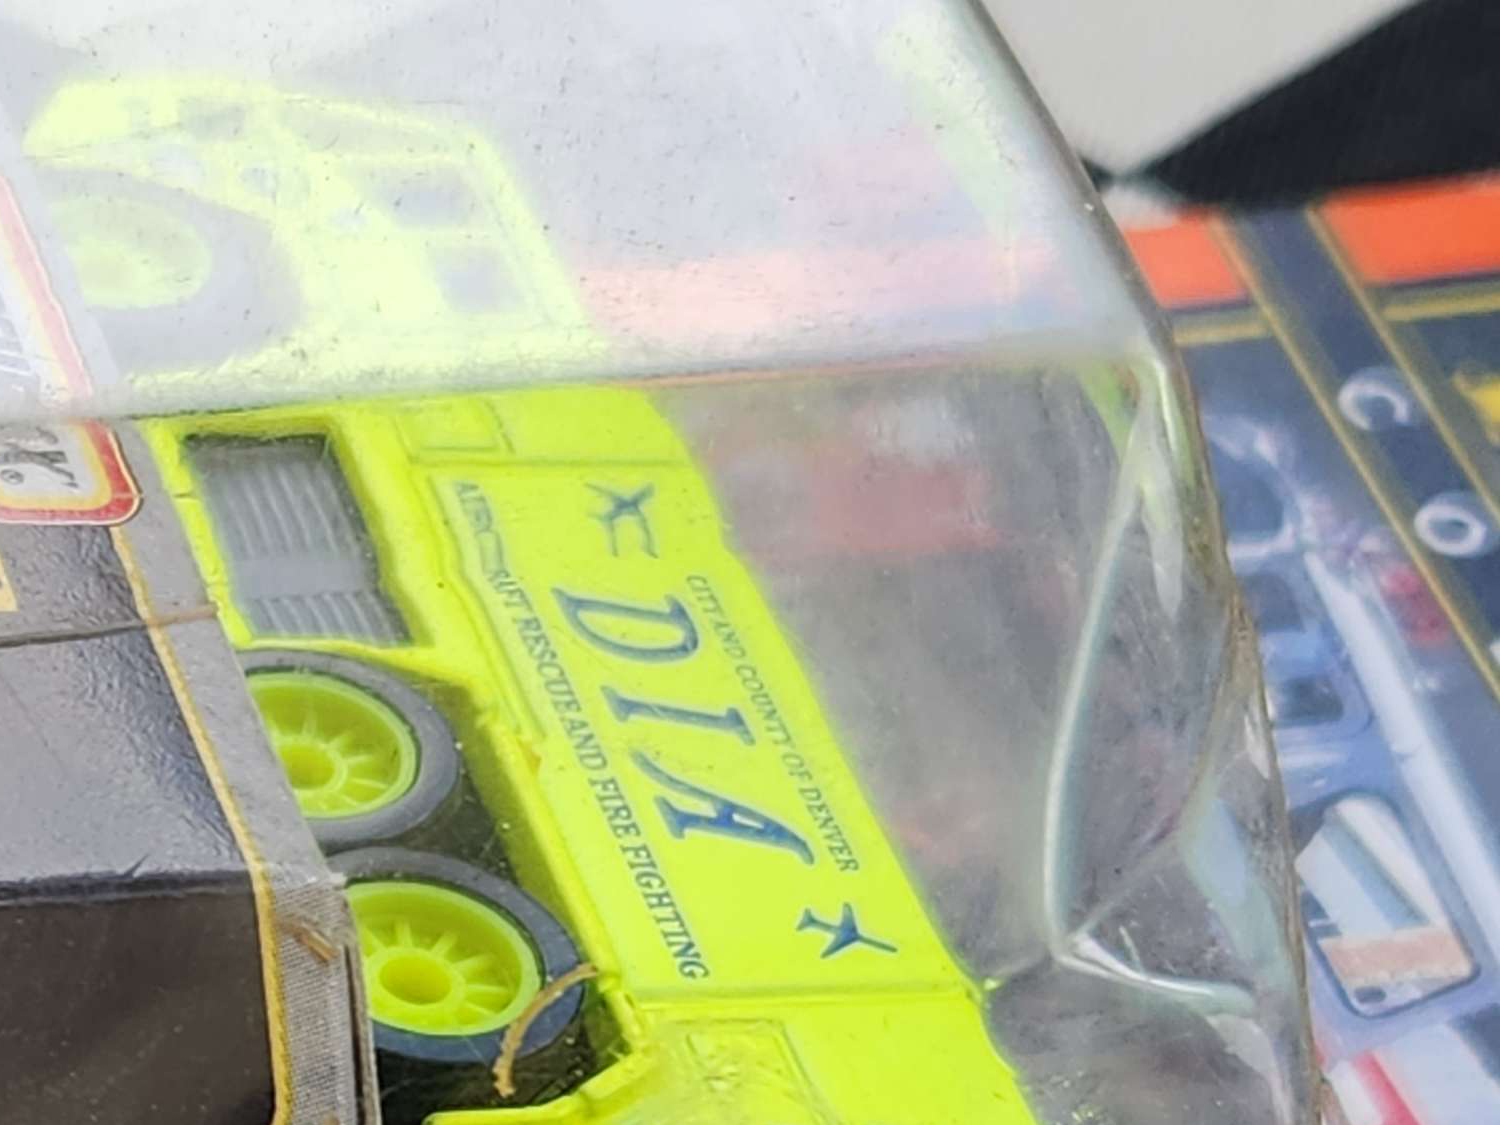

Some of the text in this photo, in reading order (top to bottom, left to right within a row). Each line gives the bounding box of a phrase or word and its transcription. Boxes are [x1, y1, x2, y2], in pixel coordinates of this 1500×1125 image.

[1338, 365, 1500, 662] CO
[512, 616, 582, 720] RESCUE
[563, 717, 608, 771] AND
[588, 776, 640, 839] FIRE
[619, 842, 710, 980] FIGHTING
[550, 586, 816, 866] DIA
[686, 574, 860, 873] CITY AND COUNTY OF DENVER
